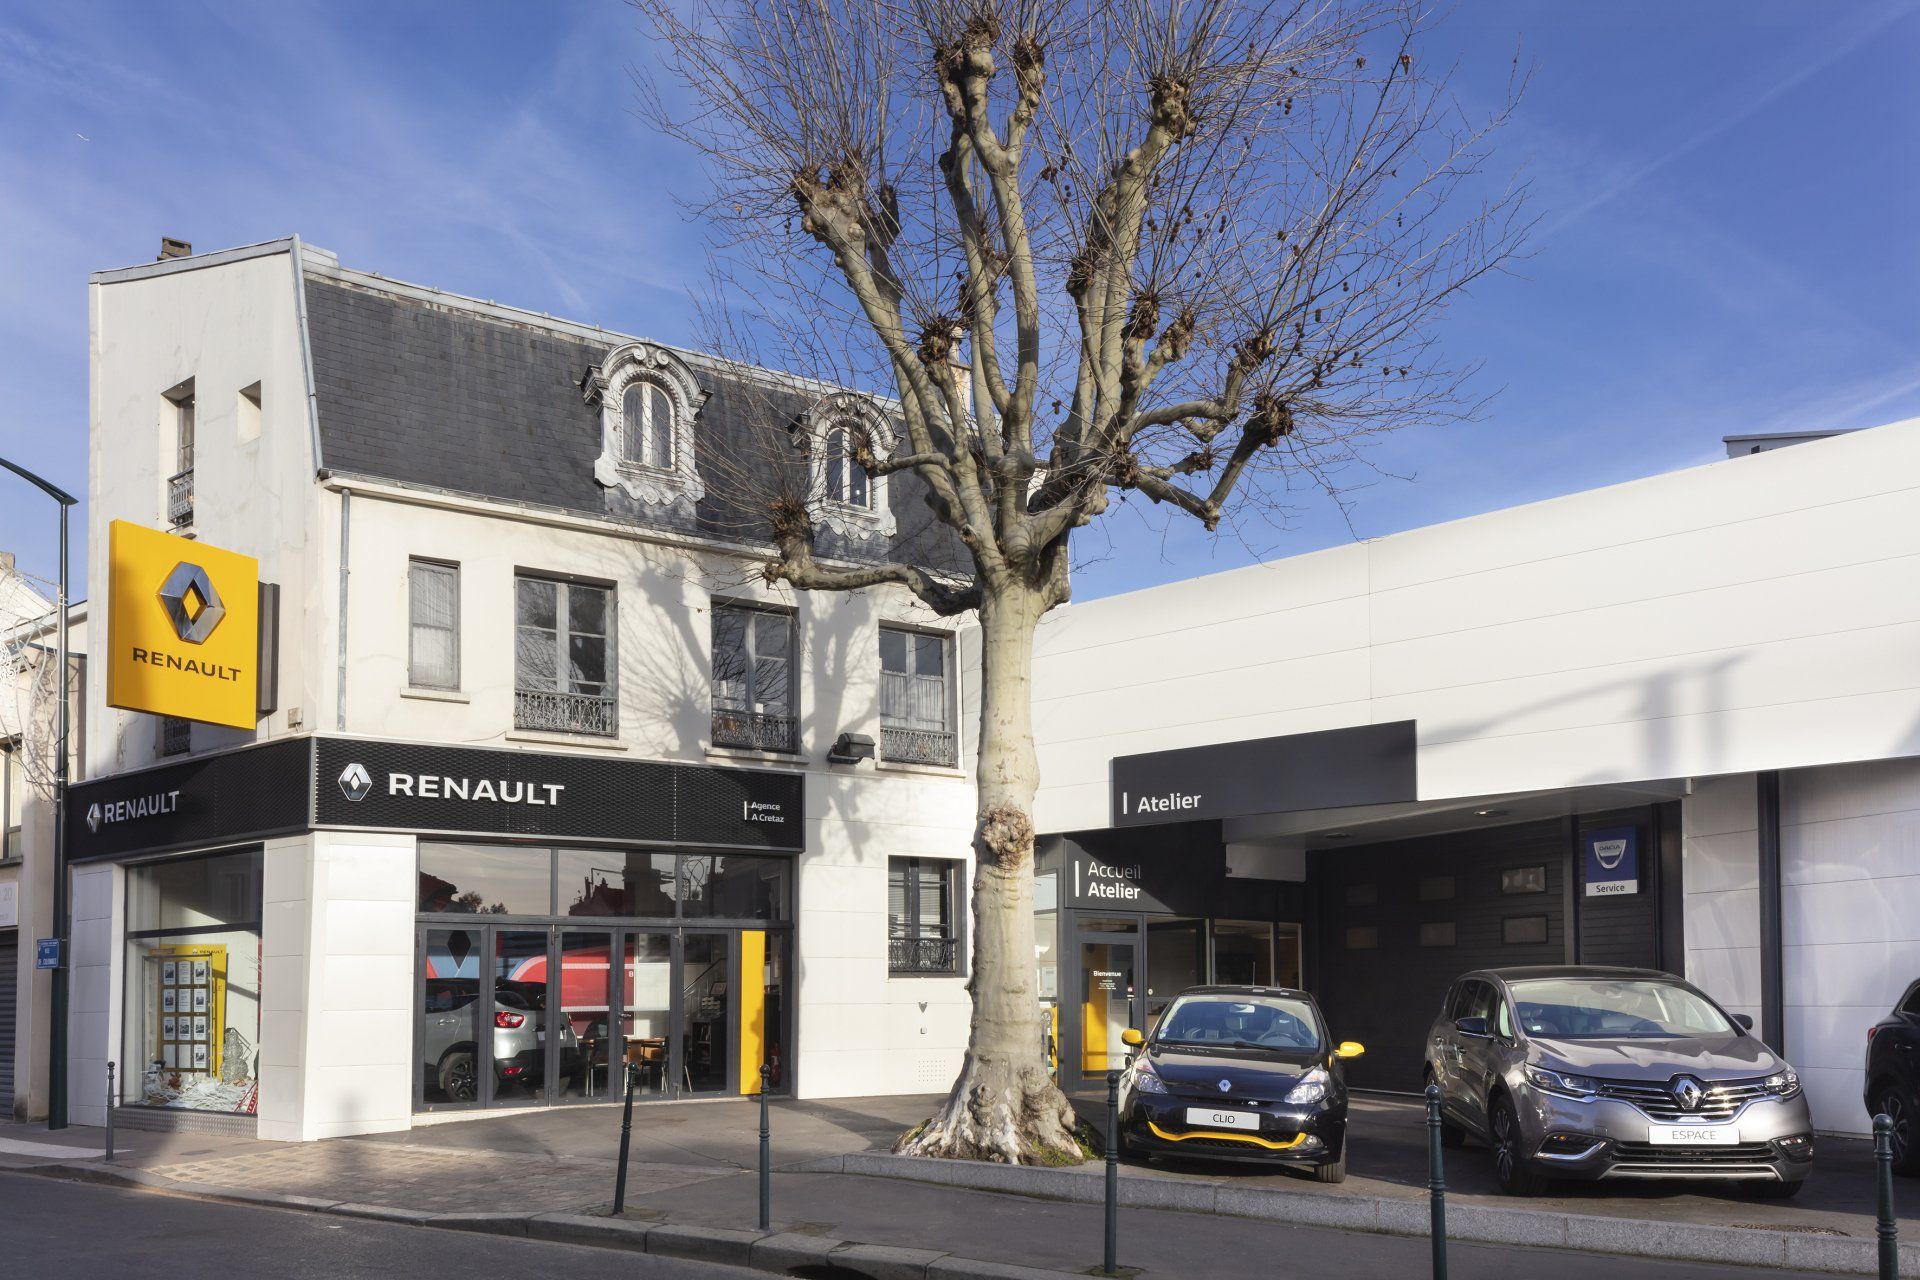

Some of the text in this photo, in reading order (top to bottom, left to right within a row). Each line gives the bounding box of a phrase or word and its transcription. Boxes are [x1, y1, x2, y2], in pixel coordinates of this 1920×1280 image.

[132, 647, 242, 682] RENAULT
[387, 773, 565, 806] RENAULT
[104, 790, 180, 824] RENAULT
[750, 801, 781, 811] Agence
[1137, 792, 1202, 813] Atelier
[751, 813, 785, 823] A Cretaz
[1088, 861, 1142, 879] Accueil
[1087, 881, 1141, 899] Atelier
[1596, 884, 1625, 893] Service
[1212, 1113, 1236, 1124] CLIO
[1672, 1130, 1717, 1140] ESPACE
